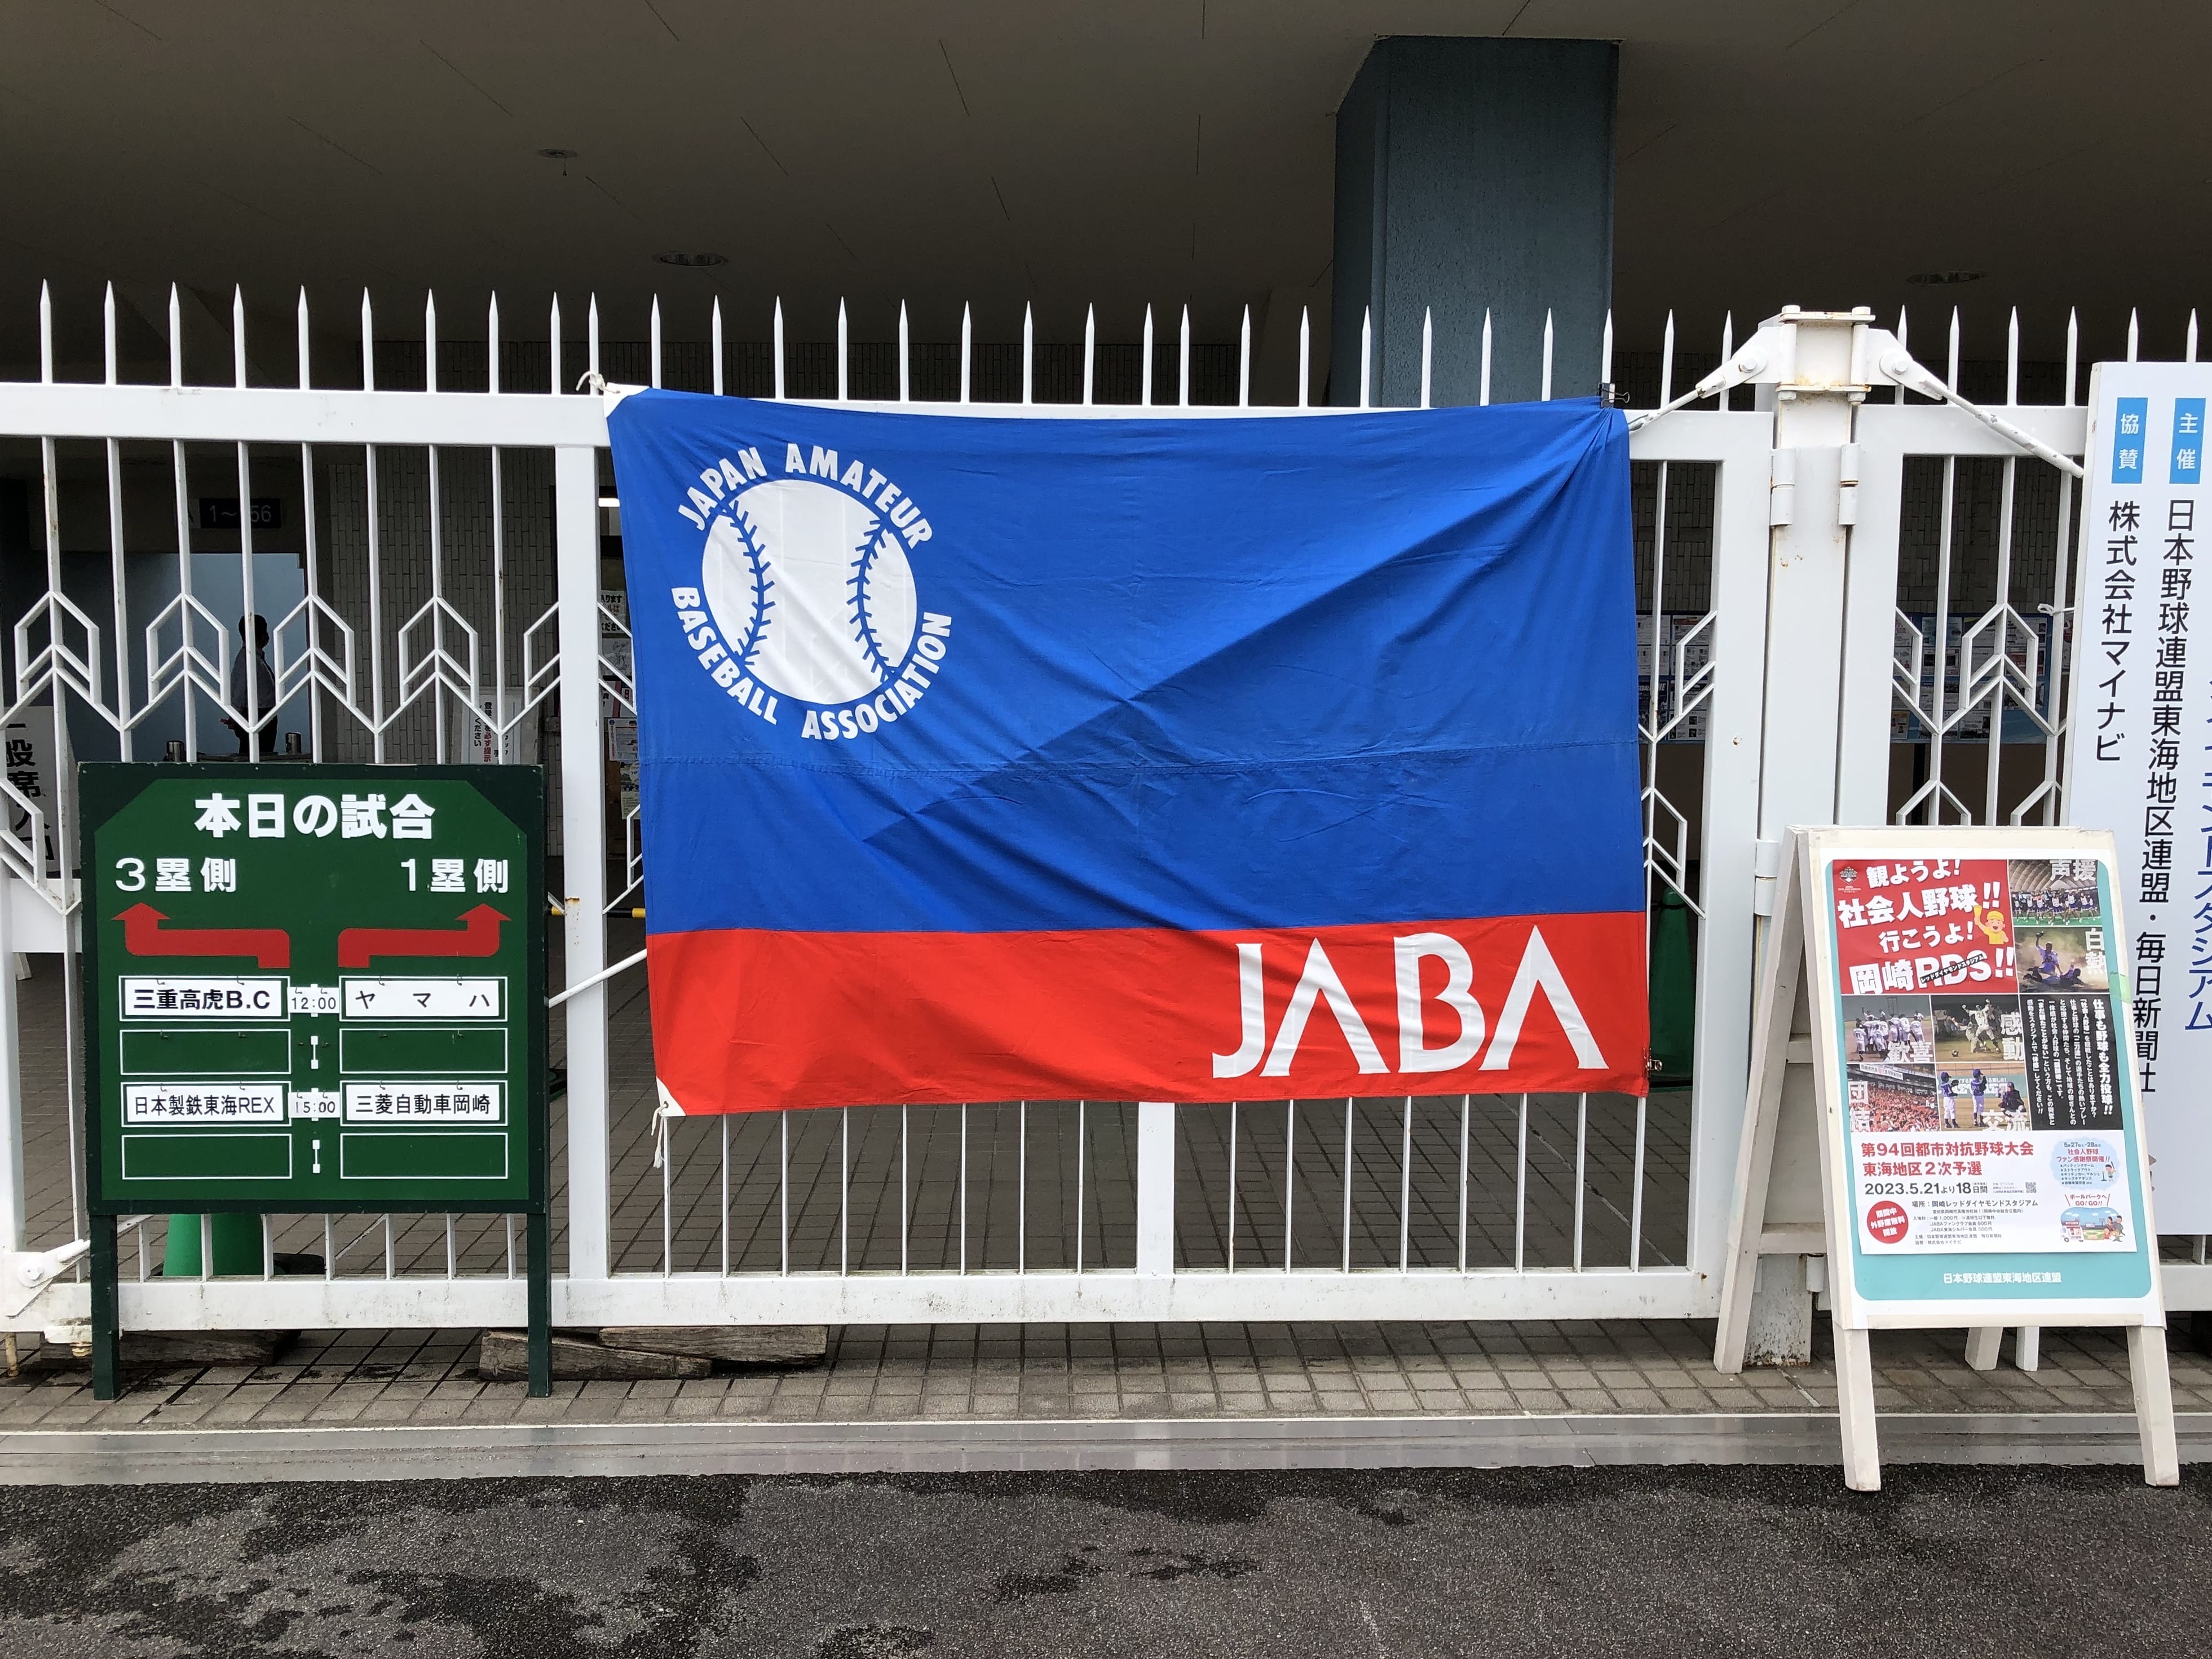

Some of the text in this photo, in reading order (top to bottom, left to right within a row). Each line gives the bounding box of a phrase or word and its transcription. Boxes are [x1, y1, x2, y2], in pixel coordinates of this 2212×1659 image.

[2176, 412, 2199, 470] 主催
[678, 443, 933, 550] JAPAN AMATEUR
[2096, 413, 2140, 762] 協賛 株式会社マイナビ
[671, 586, 952, 740] BASEBALL ASSOCIATION
[193, 791, 436, 840] 本日の試合
[114, 856, 237, 892] 3塁側
[400, 857, 509, 893] 1塁側
[2048, 859, 2096, 881] 声援
[133, 988, 271, 1011] 三重高虎B.C
[290, 996, 337, 1011] 12:00
[1212, 924, 1610, 1079] JABA
[134, 1093, 276, 1117] 日本製鉄東海REX
[294, 1099, 337, 1115] 15:00
[355, 1093, 492, 1116] 三菱自動車岡崎
[1860, 1140, 2034, 1157] 第94回都市対抗野球大会
[1862, 1161, 1983, 1177] 東海地区2次予選
[1942, 1271, 2063, 1284] 日本野球連盟東海地区連盟
